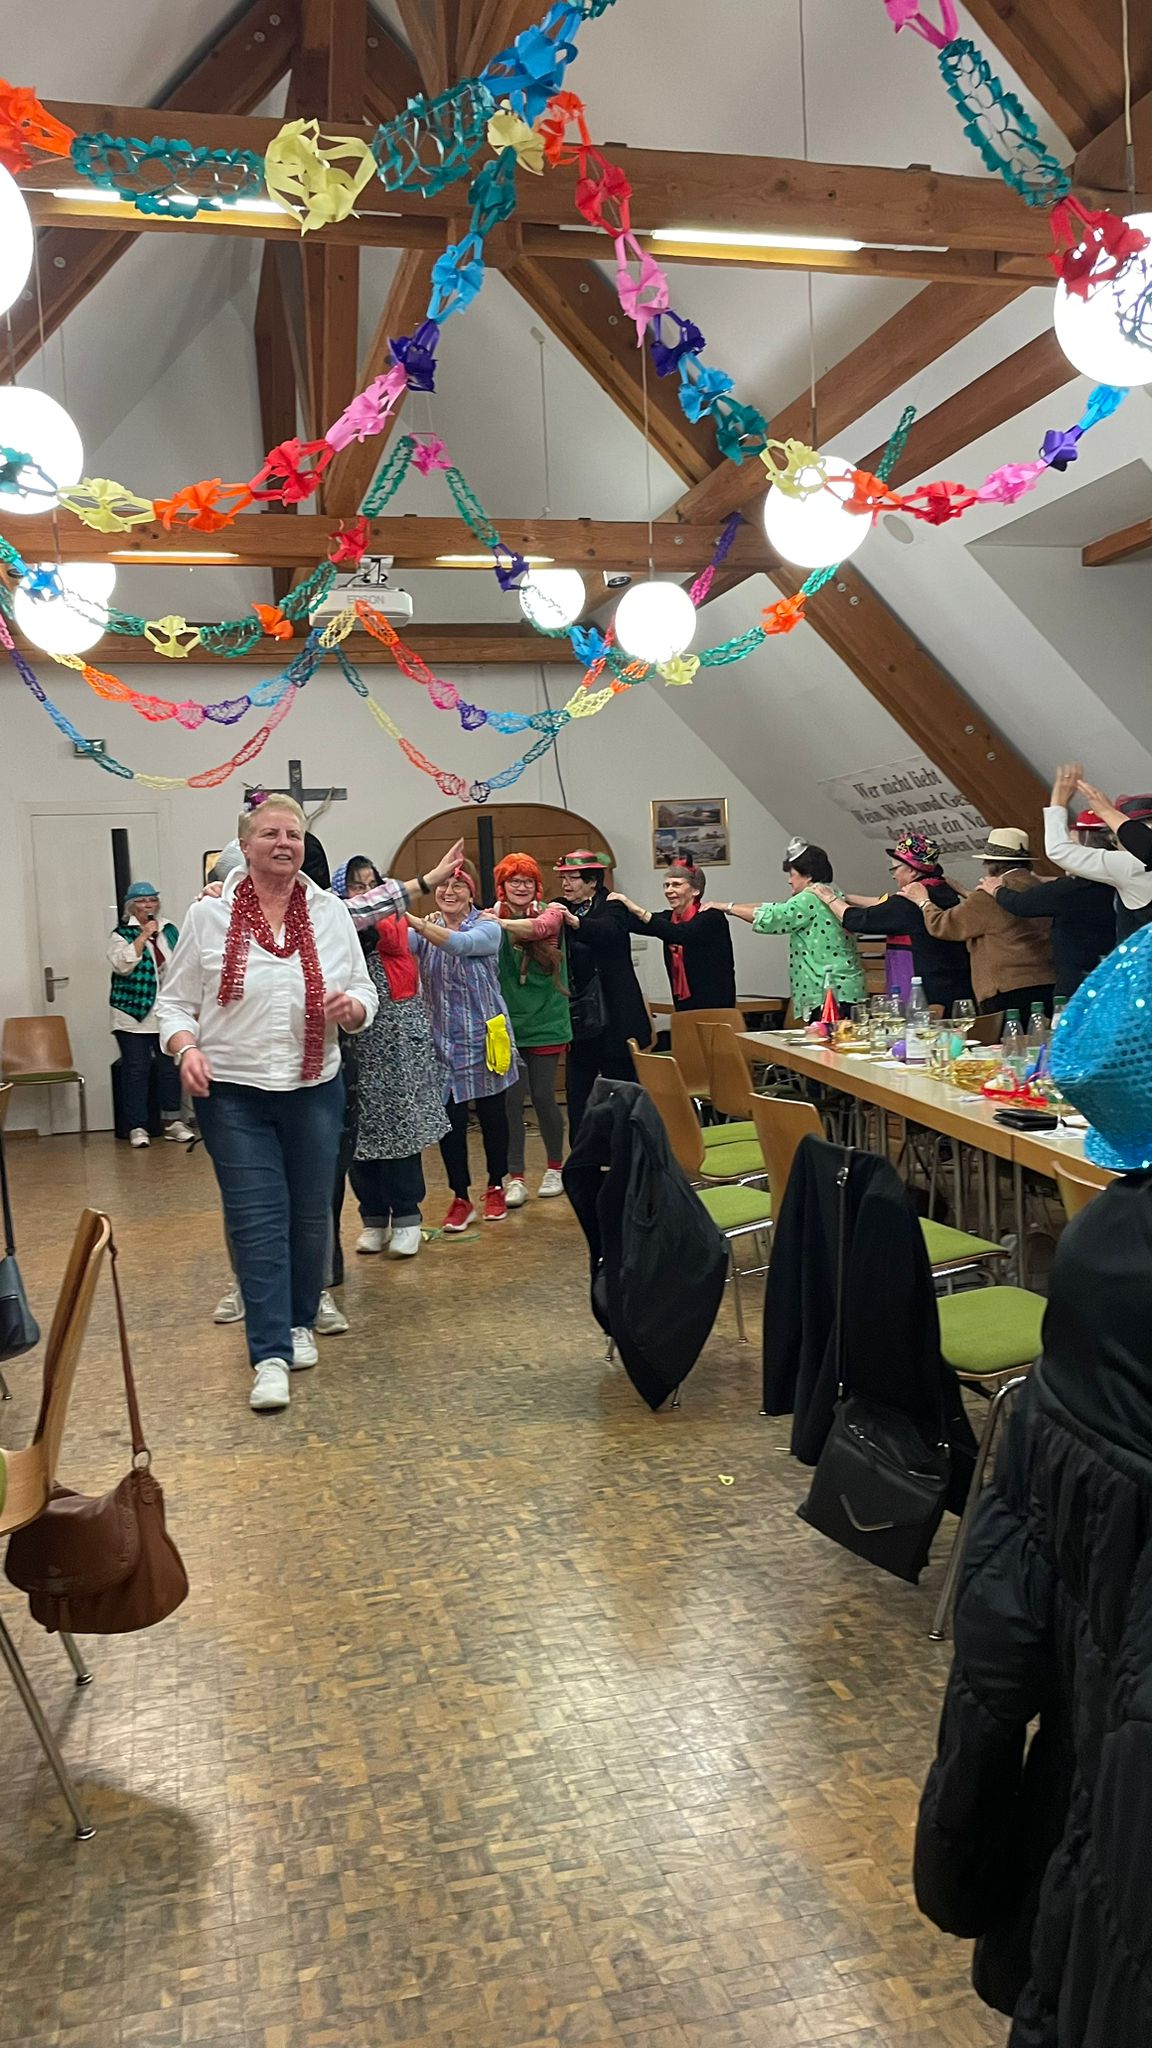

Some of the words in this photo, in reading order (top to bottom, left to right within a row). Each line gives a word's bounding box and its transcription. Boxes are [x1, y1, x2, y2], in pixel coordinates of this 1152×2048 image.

[852, 783, 880, 799] Wer
[880, 774, 913, 795] nicht
[906, 767, 942, 788] liebt
[881, 800, 918, 818] Weib
[915, 794, 946, 812] und
[941, 815, 964, 833] ein
